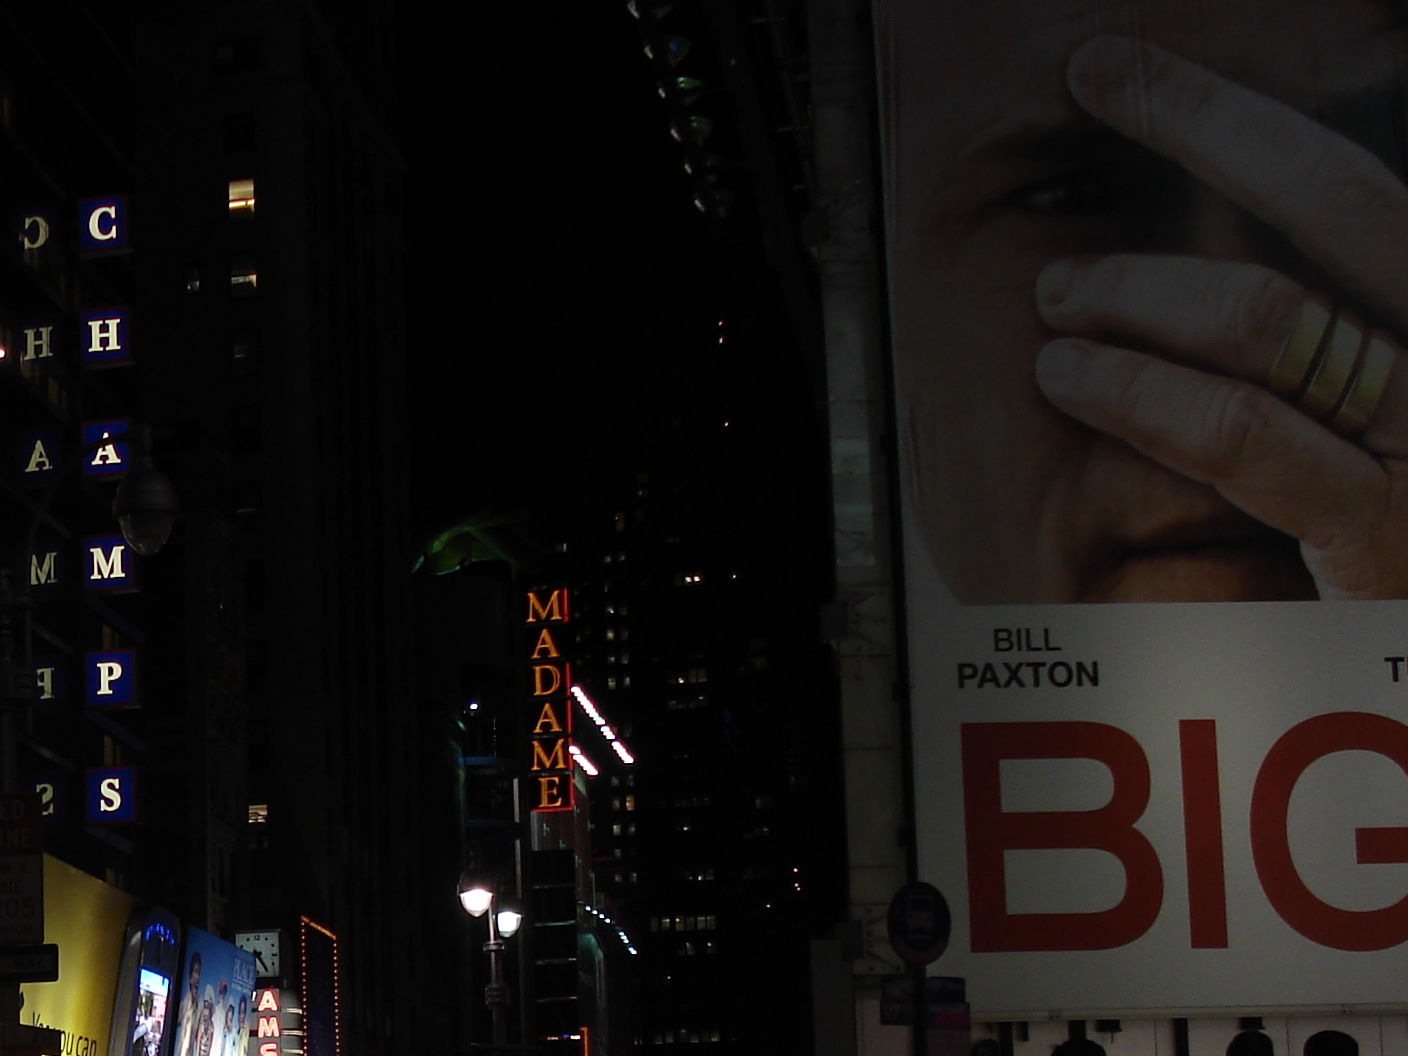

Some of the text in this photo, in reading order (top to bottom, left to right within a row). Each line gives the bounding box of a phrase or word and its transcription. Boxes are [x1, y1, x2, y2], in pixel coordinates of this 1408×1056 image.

[86, 204, 126, 818] CHAMPS
[525, 589, 566, 809] MADAME
[957, 661, 1099, 689] PAXTON
[993, 628, 1062, 652] BILL
[961, 711, 1408, 953] BIG
